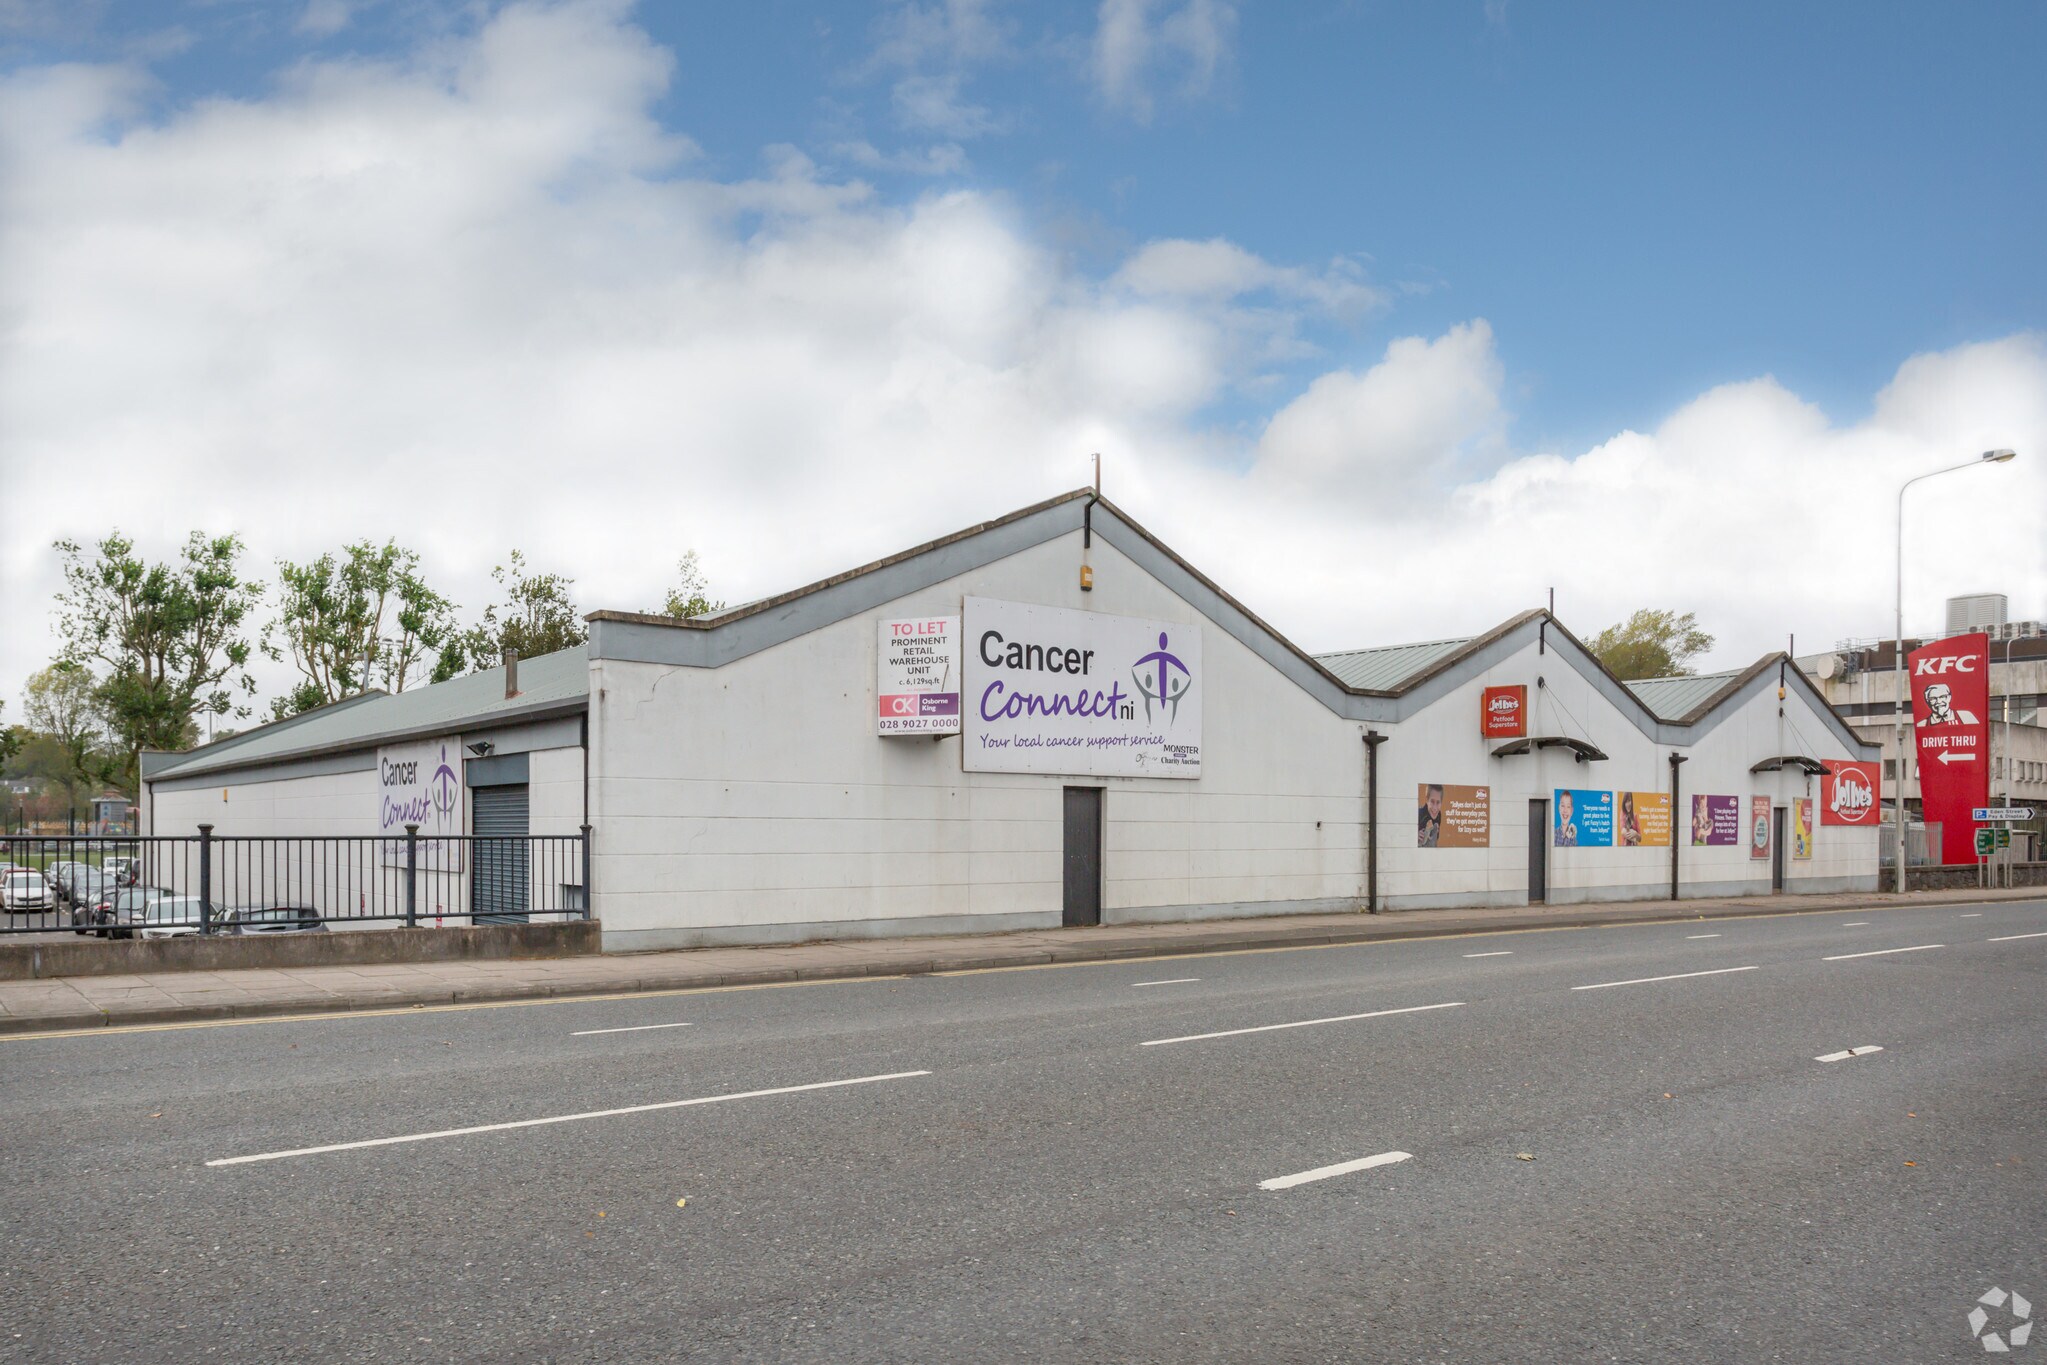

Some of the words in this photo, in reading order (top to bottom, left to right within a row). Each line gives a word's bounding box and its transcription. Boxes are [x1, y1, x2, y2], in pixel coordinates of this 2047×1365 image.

[891, 623, 913, 636] TO
[918, 621, 947, 634] LET
[891, 637, 947, 646] PROMINENT
[903, 647, 935, 655] RETAIL
[980, 630, 1094, 675] Cancer
[889, 656, 949, 665] WAREHOUSE
[1914, 655, 1977, 675] KFC
[981, 680, 1127, 721] Connect
[880, 721, 899, 729] 028
[902, 720, 928, 728] 9027
[932, 719, 959, 727] 0000
[980, 733, 1010, 748] Your
[1014, 733, 1044, 747] local
[1046, 736, 1083, 747] cancer
[1086, 733, 1129, 749] support
[1130, 732, 1165, 747] service
[1922, 736, 1948, 748] DRIVE
[1951, 736, 1976, 747] THRU
[1164, 744, 1199, 754] MONSTER
[382, 757, 418, 787] Cancer
[383, 787, 430, 829] Connect
